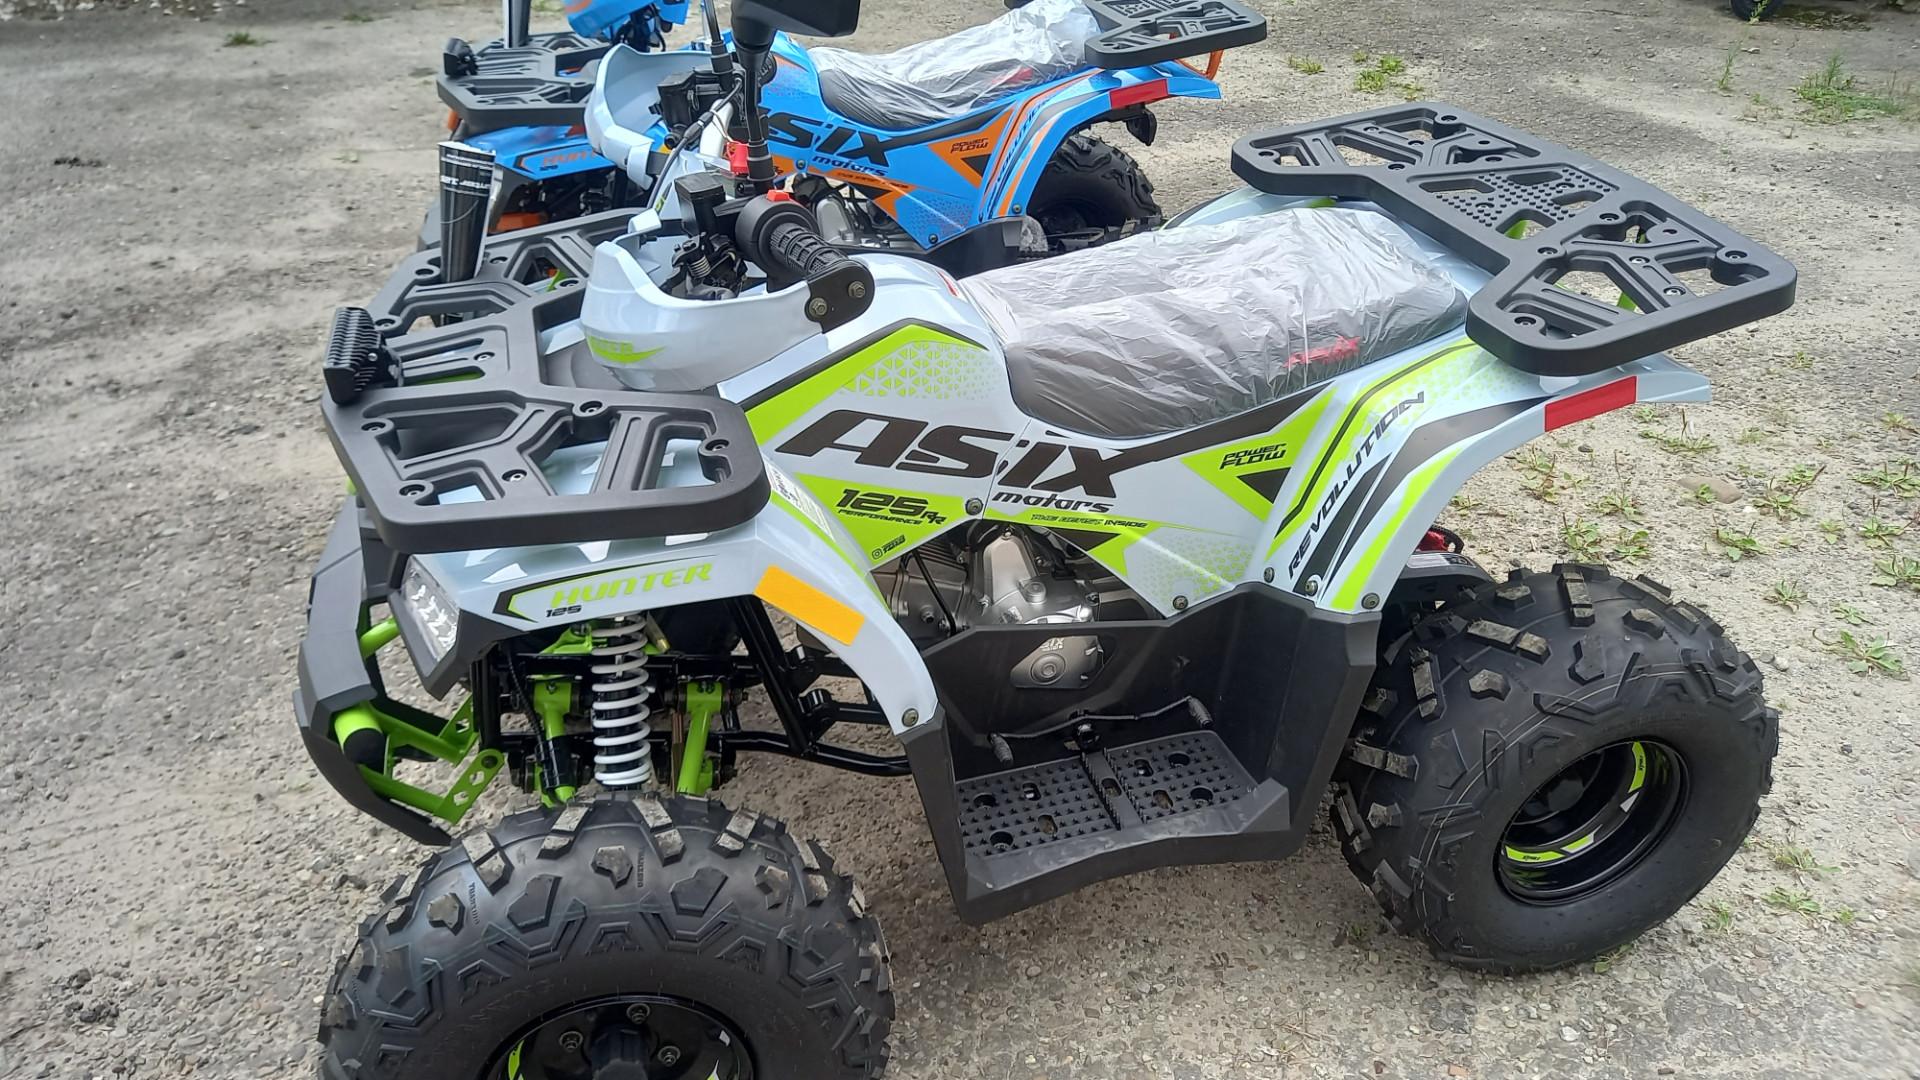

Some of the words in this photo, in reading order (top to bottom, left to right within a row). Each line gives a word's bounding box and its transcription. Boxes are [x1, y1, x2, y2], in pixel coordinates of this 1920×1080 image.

[758, 107, 889, 168] SIX
[950, 142, 989, 153] FLOW
[811, 155, 888, 177] motors
[775, 409, 1117, 498] ASIX
[1219, 450, 1288, 470] FLOW
[1223, 443, 1288, 460] POWER
[1288, 390, 1425, 580] REVOLUTION
[836, 488, 929, 517] 125
[992, 492, 1114, 513] motors
[838, 508, 924, 525] PERFORMANCE
[1104, 519, 1148, 529] INSIDE
[551, 563, 713, 608] HUNTER
[545, 604, 583, 618] 125
